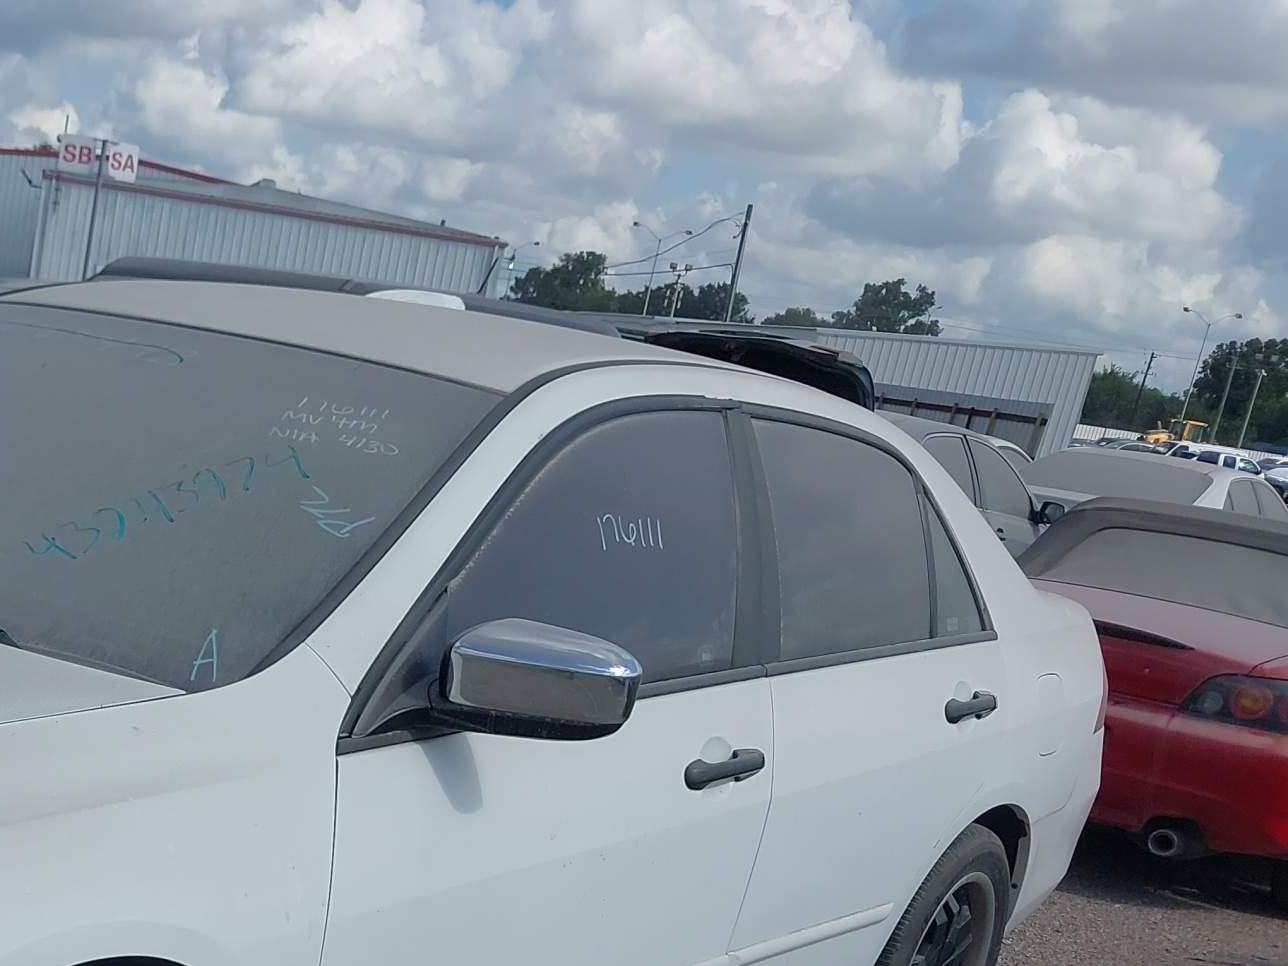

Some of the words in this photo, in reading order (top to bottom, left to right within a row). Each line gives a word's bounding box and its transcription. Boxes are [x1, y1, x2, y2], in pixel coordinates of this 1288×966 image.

[62, 143, 92, 165] SB
[110, 151, 135, 173] SA
[596, 513, 664, 551] 176111
[190, 628, 219, 683] A
